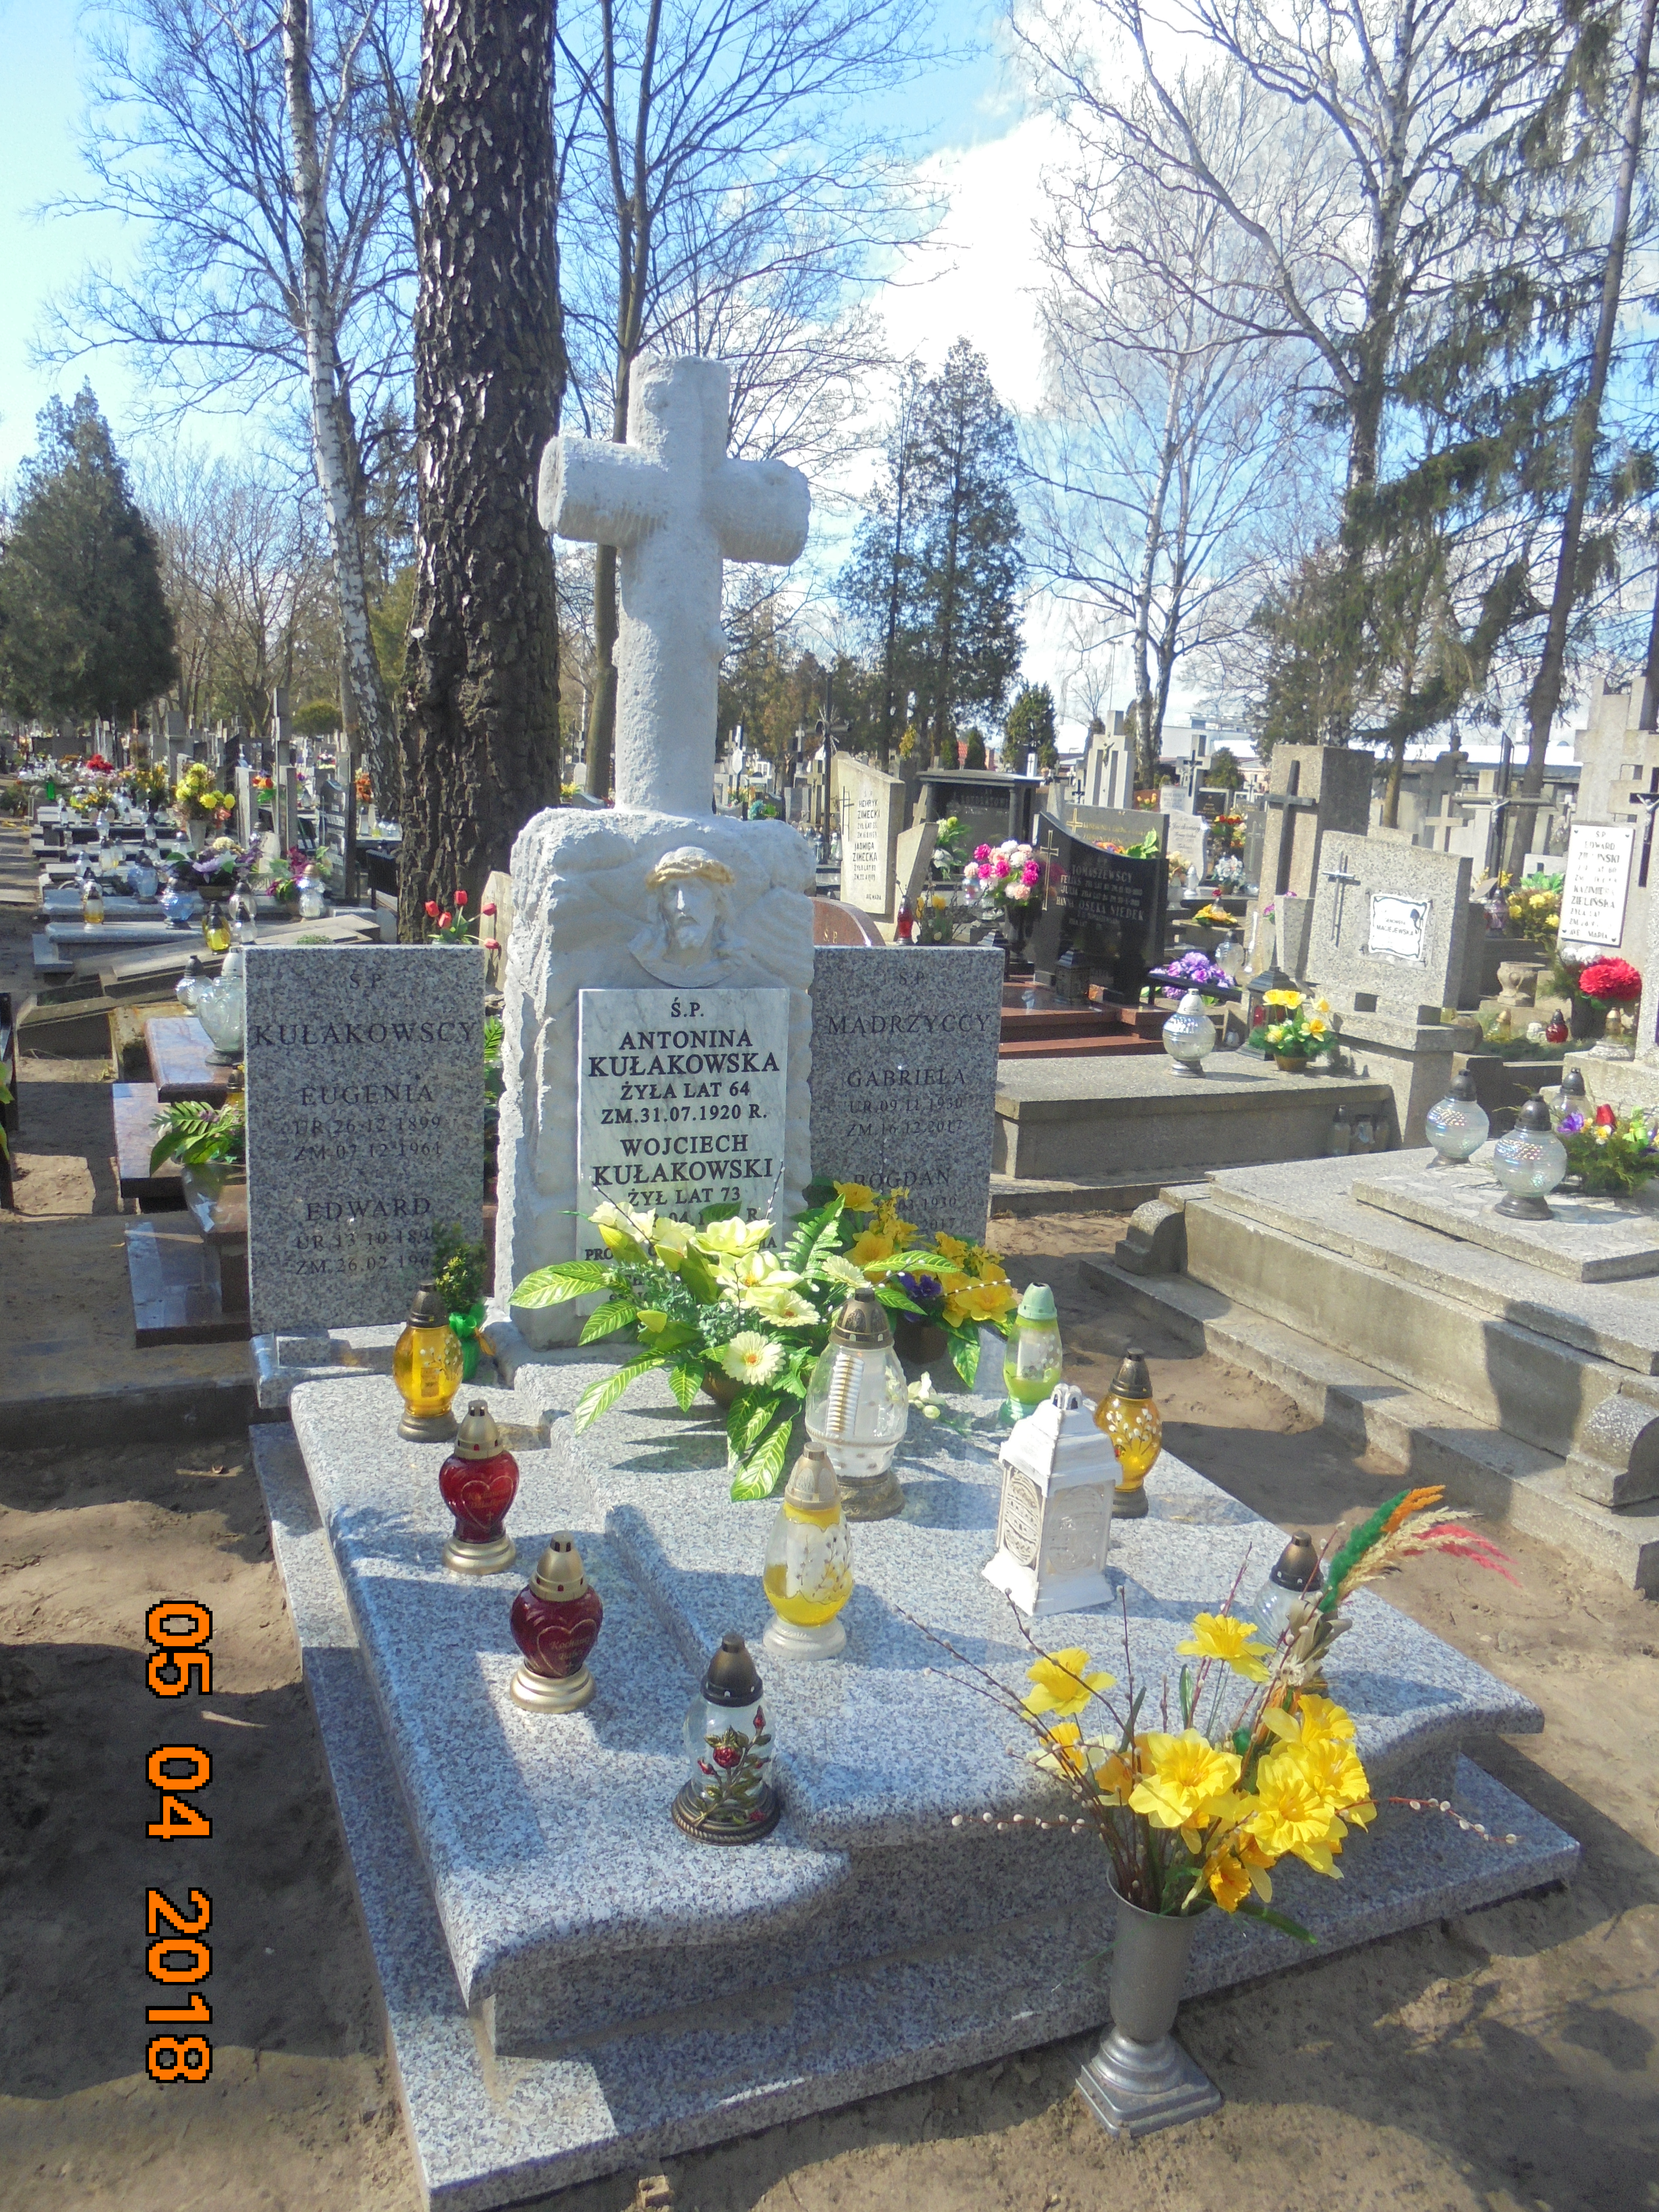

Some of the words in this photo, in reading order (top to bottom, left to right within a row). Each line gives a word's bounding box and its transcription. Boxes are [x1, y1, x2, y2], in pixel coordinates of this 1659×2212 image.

[859, 799, 878, 808] HENRYK
[854, 842, 874, 851] JADWIGA
[254, 1021, 477, 1046] KUŁAKOWSCY
[619, 1029, 753, 1050] ANTONINA
[588, 1052, 780, 1077] KUŁAKOWSKA
[847, 1069, 965, 1088] GABRIELA
[302, 1084, 434, 1106] EUGENIA
[620, 1081, 677, 1100] ŻYŁA
[684, 1082, 722, 1098] LAT
[729, 1080, 750, 1097] 64
[748, 1104, 767, 1119] R.
[620, 1134, 749, 1157] WOJCIECH
[592, 1158, 773, 1186] KUŁAKOWSKI
[628, 1188, 668, 1207] ŻYŁ
[675, 1188, 714, 1204] LAT
[720, 1186, 741, 1201] 73
[307, 1197, 430, 1221] EDWARD
